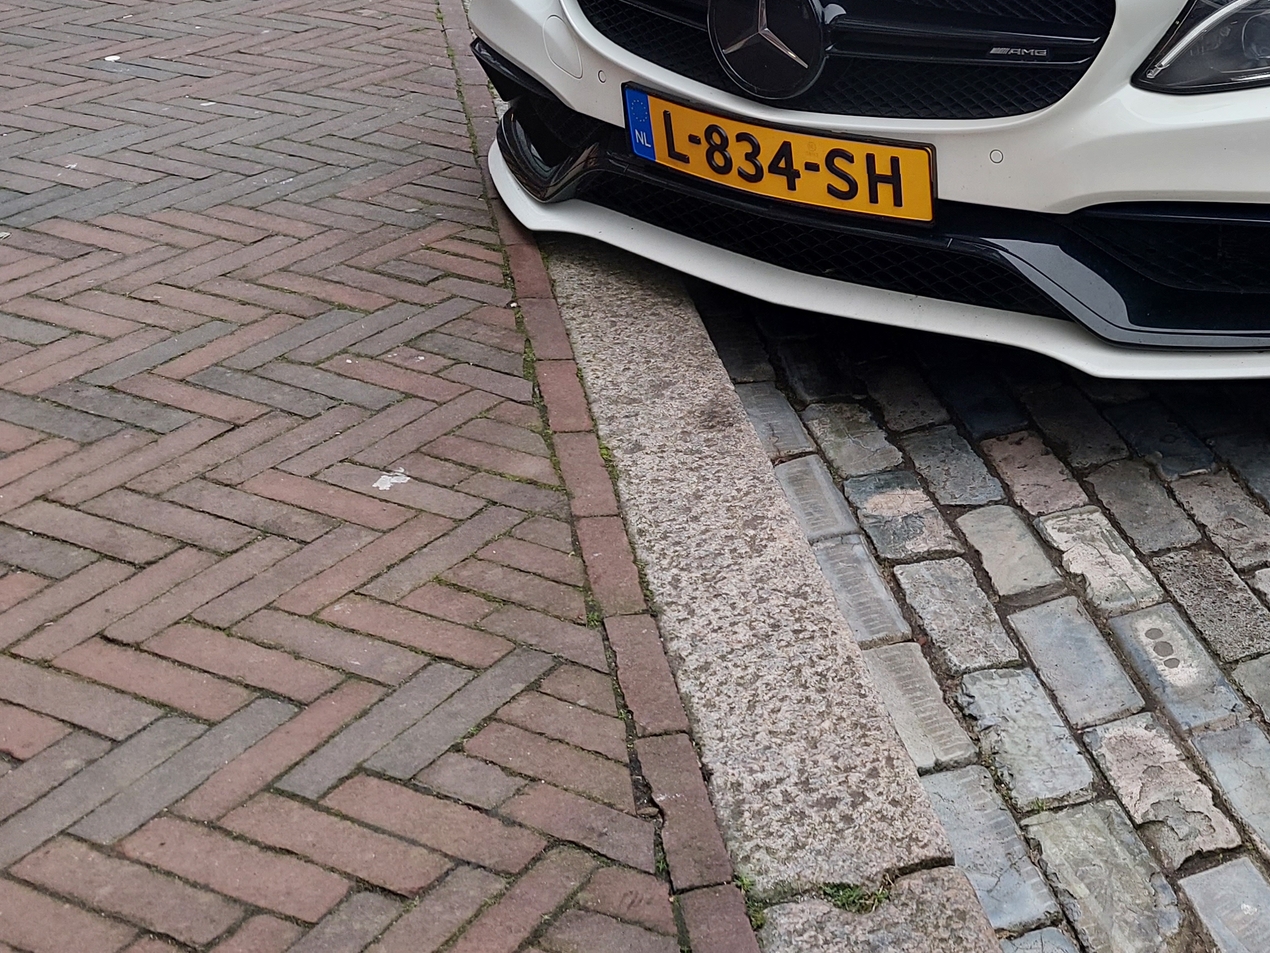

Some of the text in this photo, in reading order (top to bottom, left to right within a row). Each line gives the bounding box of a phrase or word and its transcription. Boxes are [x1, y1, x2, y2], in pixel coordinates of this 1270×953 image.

[1008, 48, 1047, 57] AMG
[634, 129, 652, 148] NL
[662, 109, 904, 208] L-834-SH
